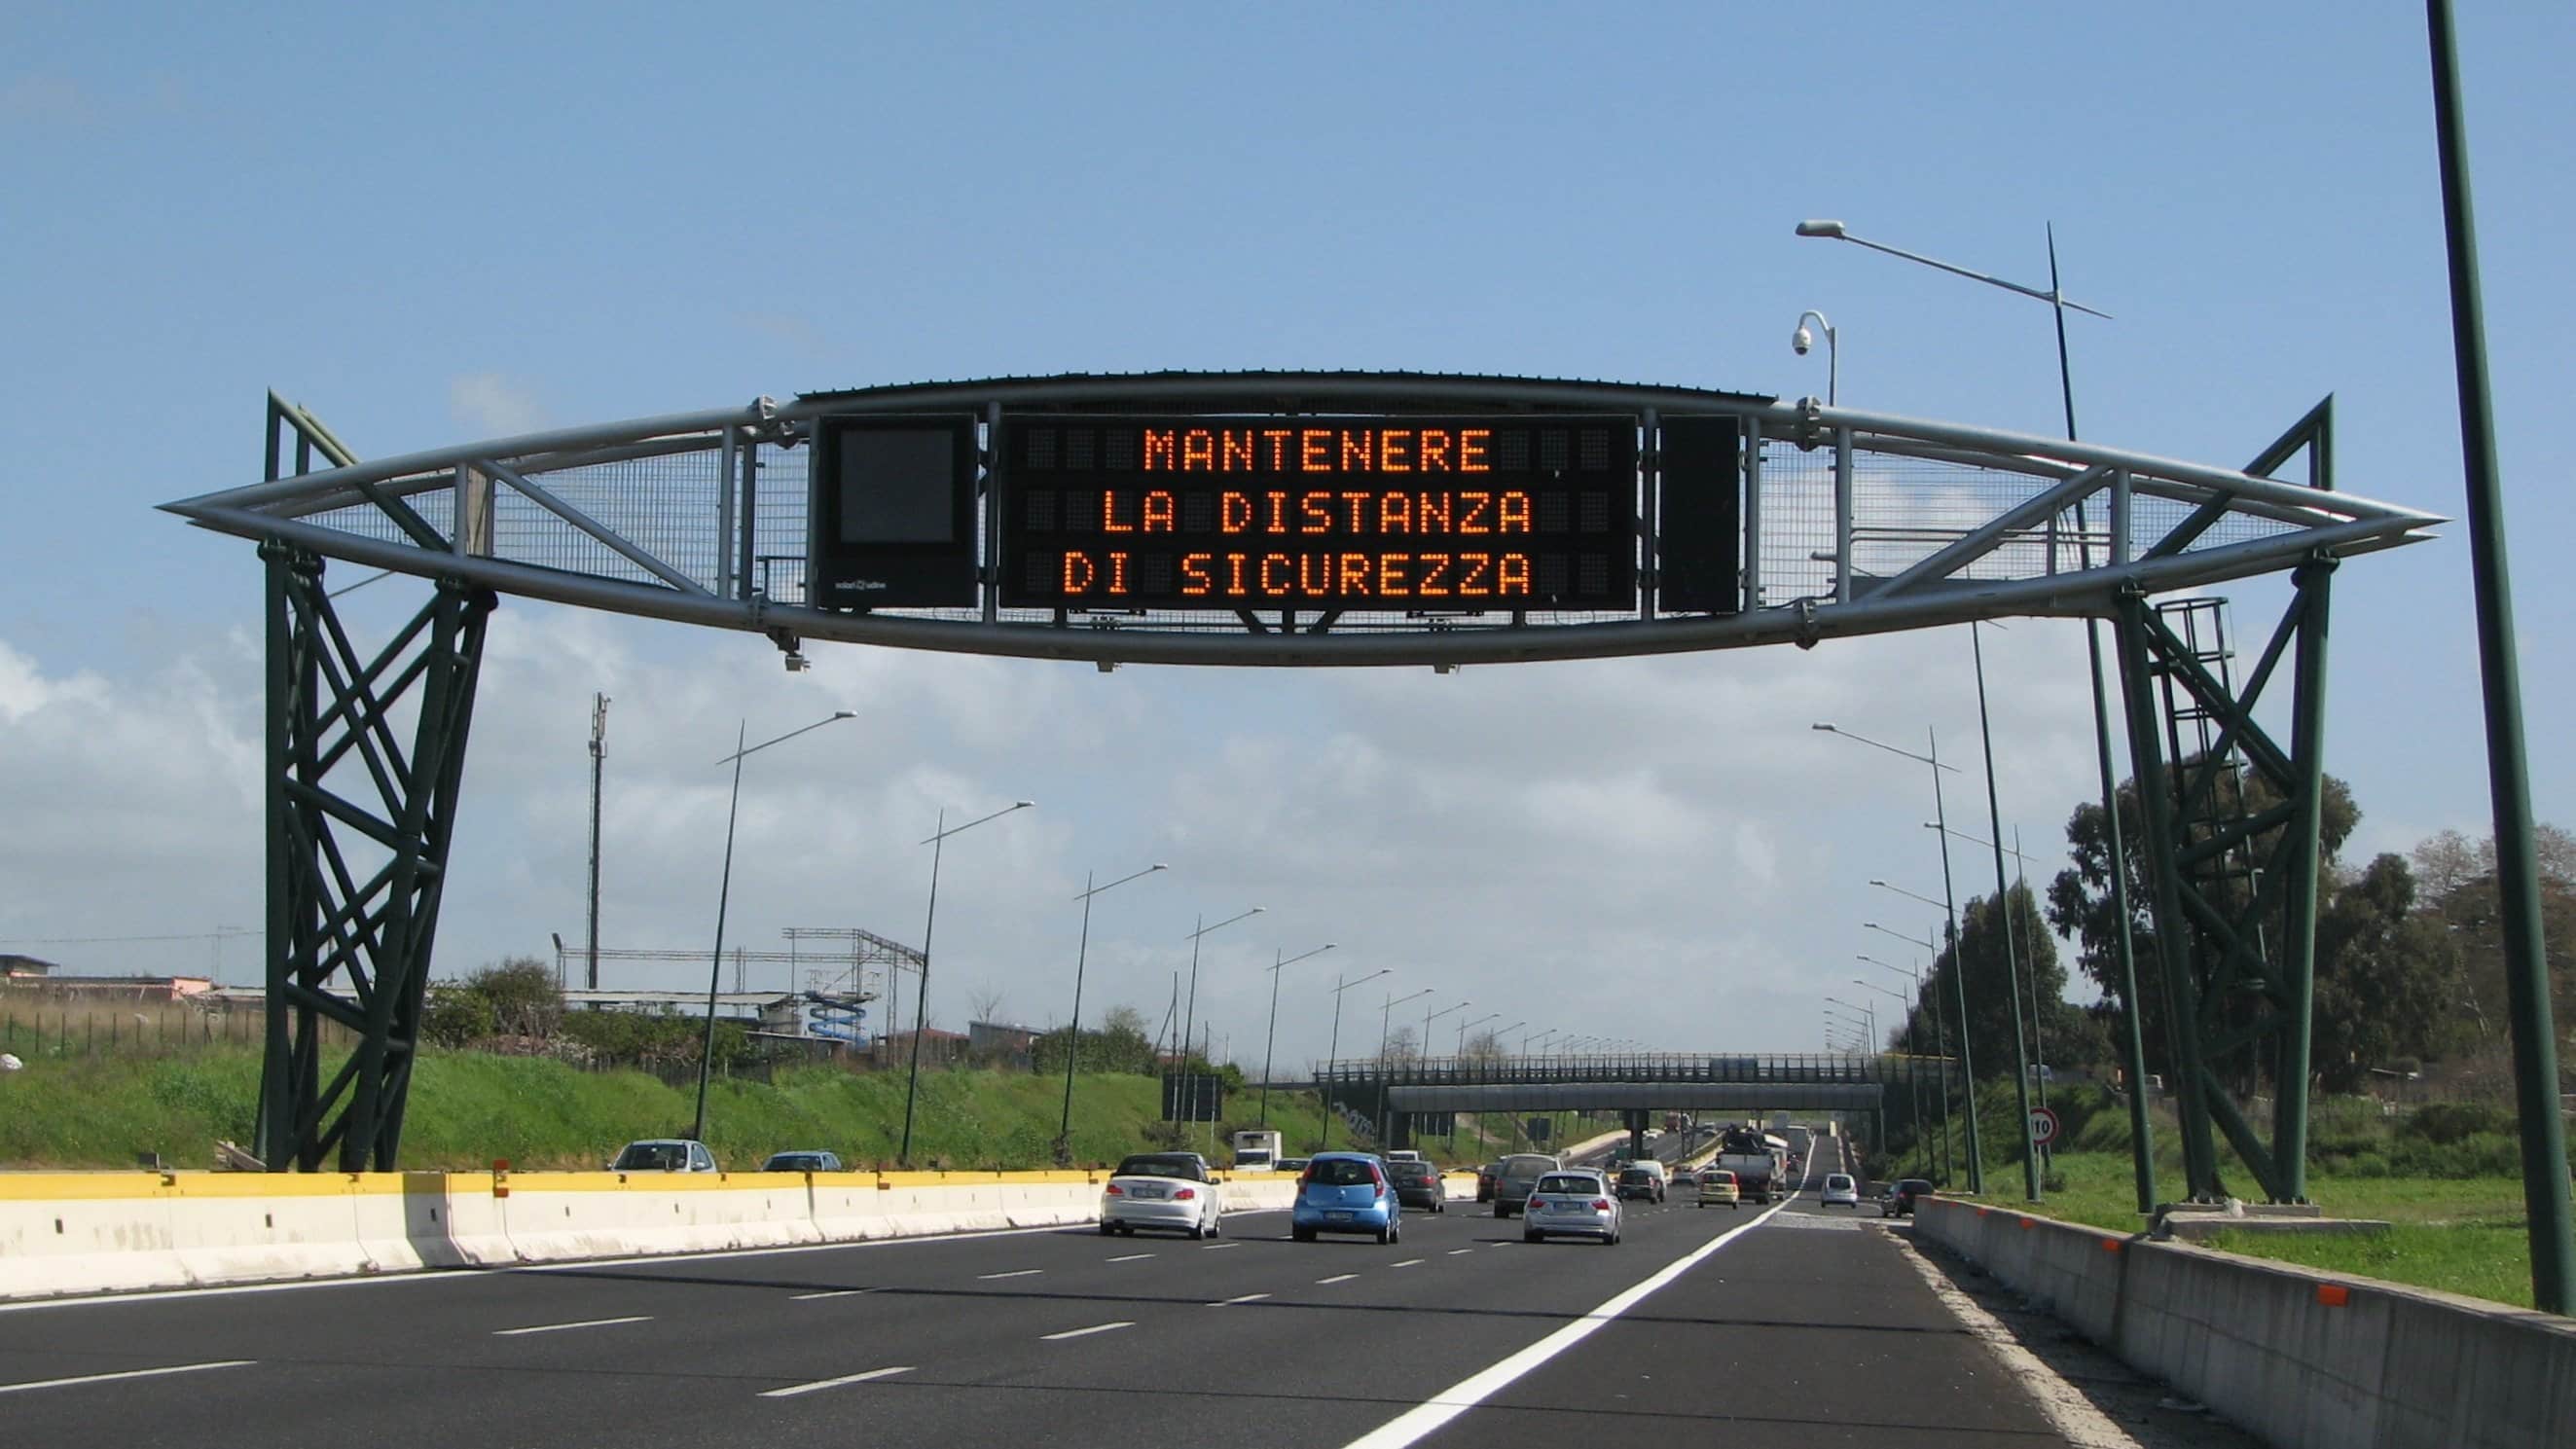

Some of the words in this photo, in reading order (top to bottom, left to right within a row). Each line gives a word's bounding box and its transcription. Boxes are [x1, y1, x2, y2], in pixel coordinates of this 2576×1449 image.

[1144, 429, 1490, 472] MANTENERE
[1105, 490, 1173, 531] LA
[1222, 490, 1530, 533] DISTANZA
[1064, 551, 1128, 593] DI
[1182, 553, 1530, 596] SICUREZZA
